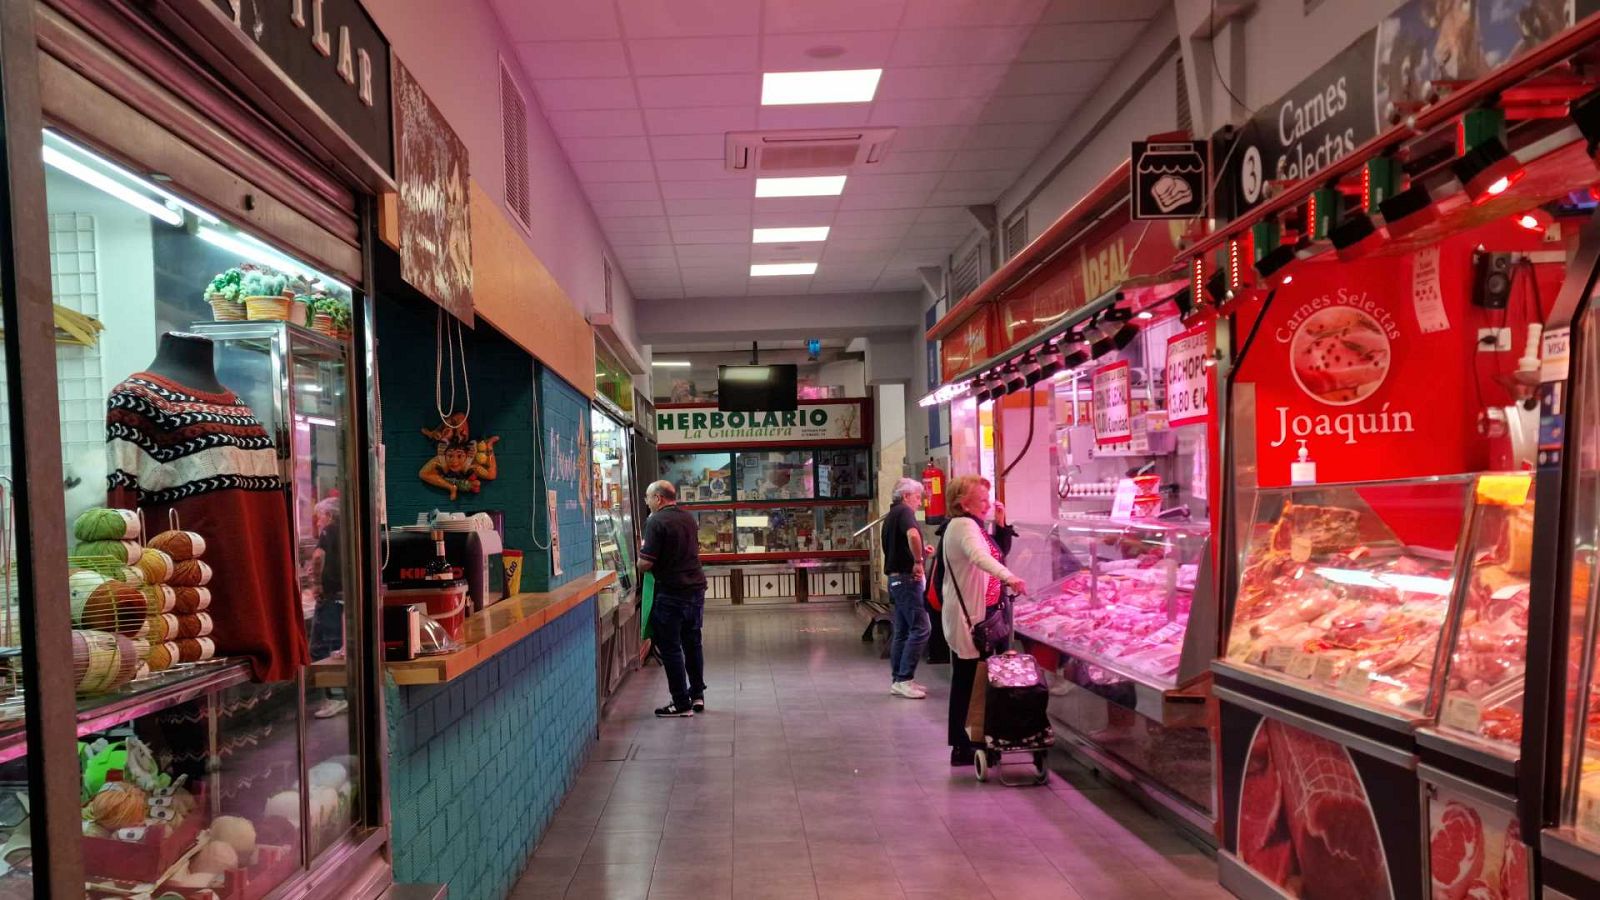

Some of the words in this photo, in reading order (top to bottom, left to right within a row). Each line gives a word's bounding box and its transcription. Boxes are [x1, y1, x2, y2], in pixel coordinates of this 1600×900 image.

[1279, 76, 1347, 146] Carnes
[1245, 155, 1257, 195] 3
[1080, 237, 1129, 305] IDEAL
[1275, 294, 1331, 343] Carnes
[1336, 287, 1400, 340] Selectas
[657, 409, 828, 430] HERBOLARIO
[683, 429, 702, 440] La
[1270, 402, 1415, 447] Joaquín
